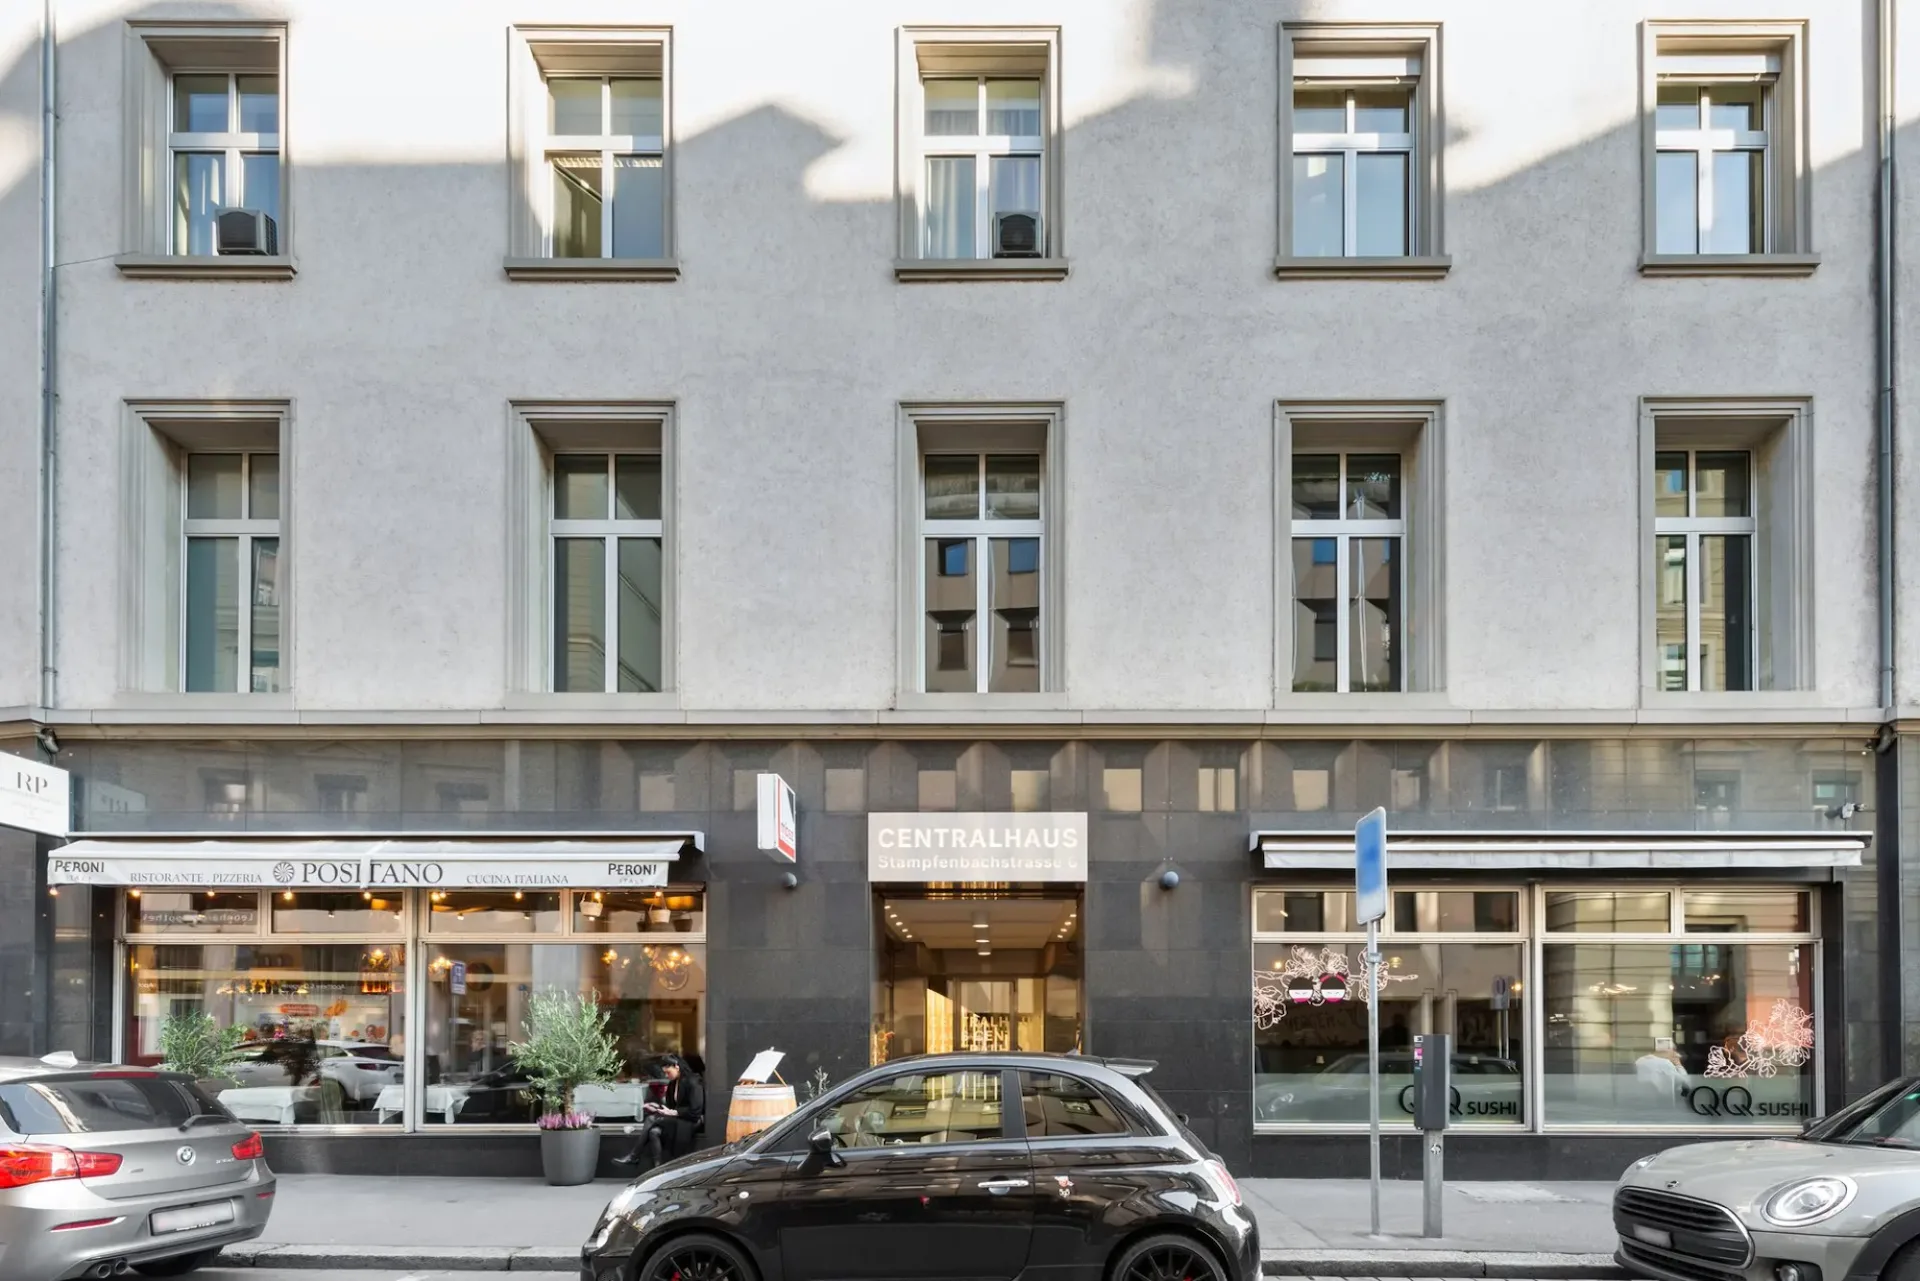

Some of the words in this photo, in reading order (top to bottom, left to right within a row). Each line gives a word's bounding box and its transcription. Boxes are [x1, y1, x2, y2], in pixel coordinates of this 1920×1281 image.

[16, 771, 49, 794] RP
[878, 828, 1078, 849] CENTRALHAUS
[54, 860, 105, 874] PERONI
[608, 863, 657, 876] PERONI
[878, 855, 1062, 871] Stampfenbachstrasse
[130, 873, 204, 883] RISTORANTE
[212, 873, 263, 883] PIZZERIA
[302, 863, 443, 884] POSITANO
[466, 874, 511, 885] CUCINA
[514, 874, 569, 885] ITALIANA
[1467, 1101, 1517, 1115] SUSHI
[1690, 1086, 1754, 1116] QQ
[1758, 1103, 1809, 1116] SUSHI
